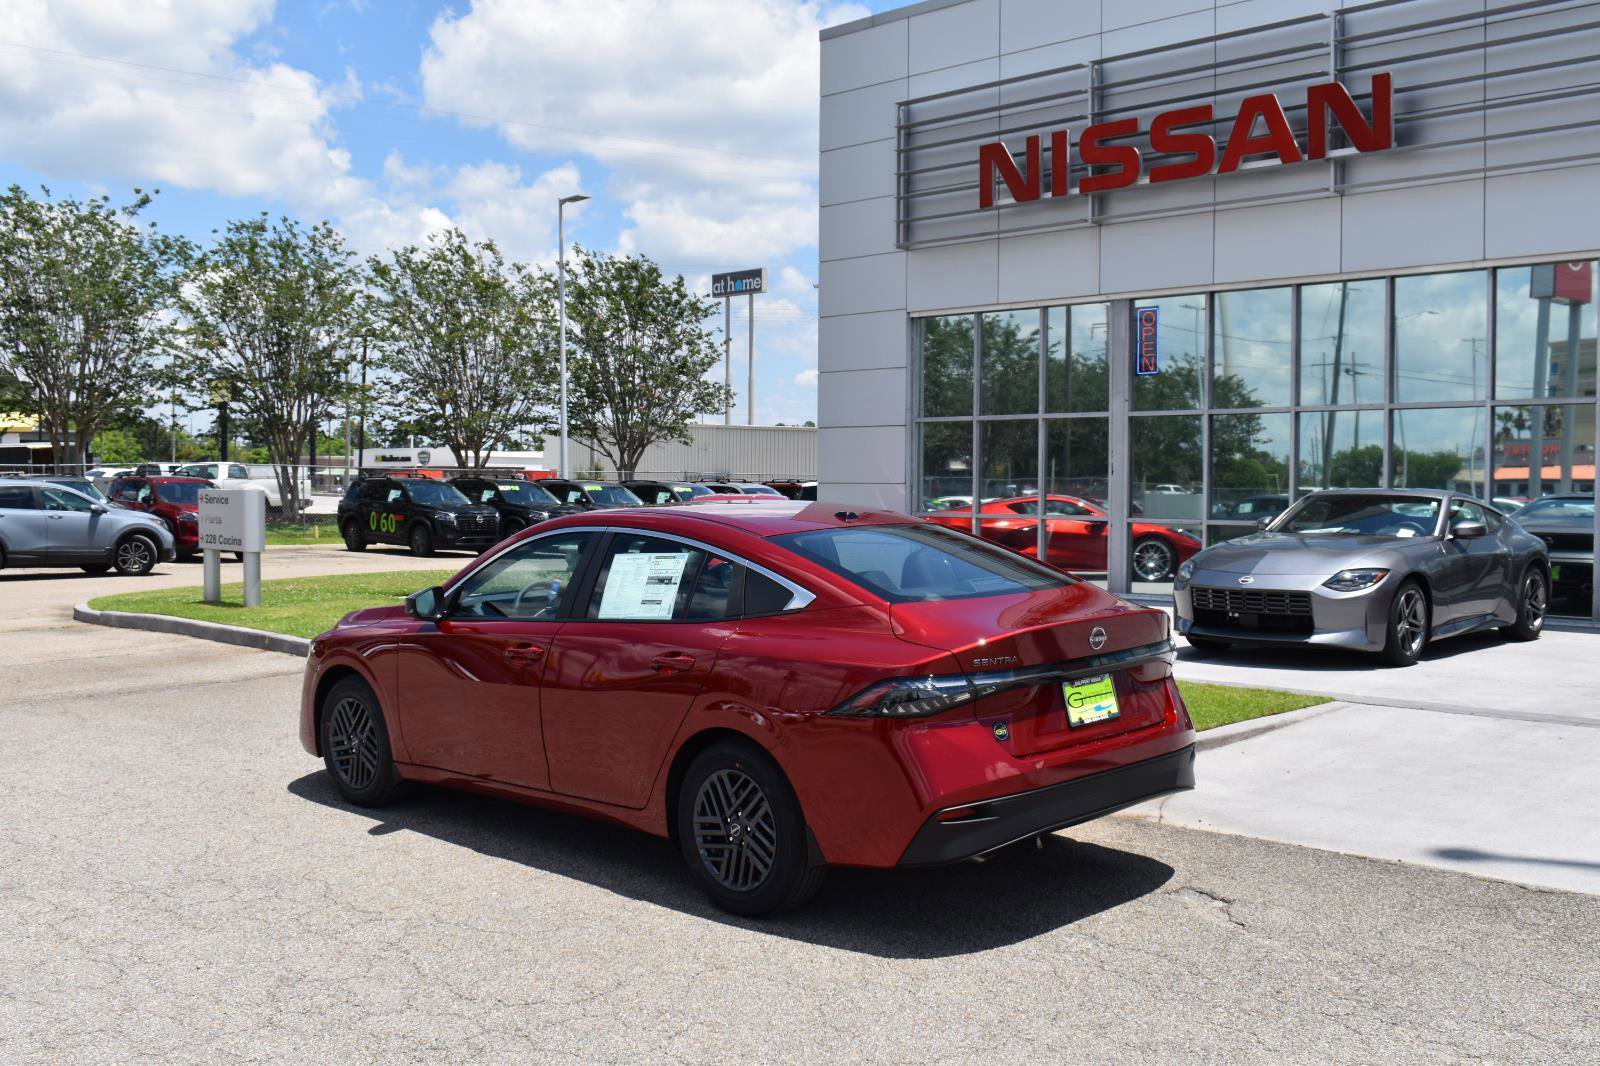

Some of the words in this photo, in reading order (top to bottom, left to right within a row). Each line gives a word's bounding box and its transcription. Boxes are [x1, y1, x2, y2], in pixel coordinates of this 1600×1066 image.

[979, 72, 1393, 208] NISSAN
[713, 279, 725, 293] at
[727, 276, 761, 291] home
[1142, 311, 1155, 372] OPEN
[204, 494, 229, 504] Service
[381, 512, 396, 533] 60
[205, 534, 217, 544] 228
[218, 534, 242, 546] Cocina
[973, 656, 1018, 667] SENTRA
